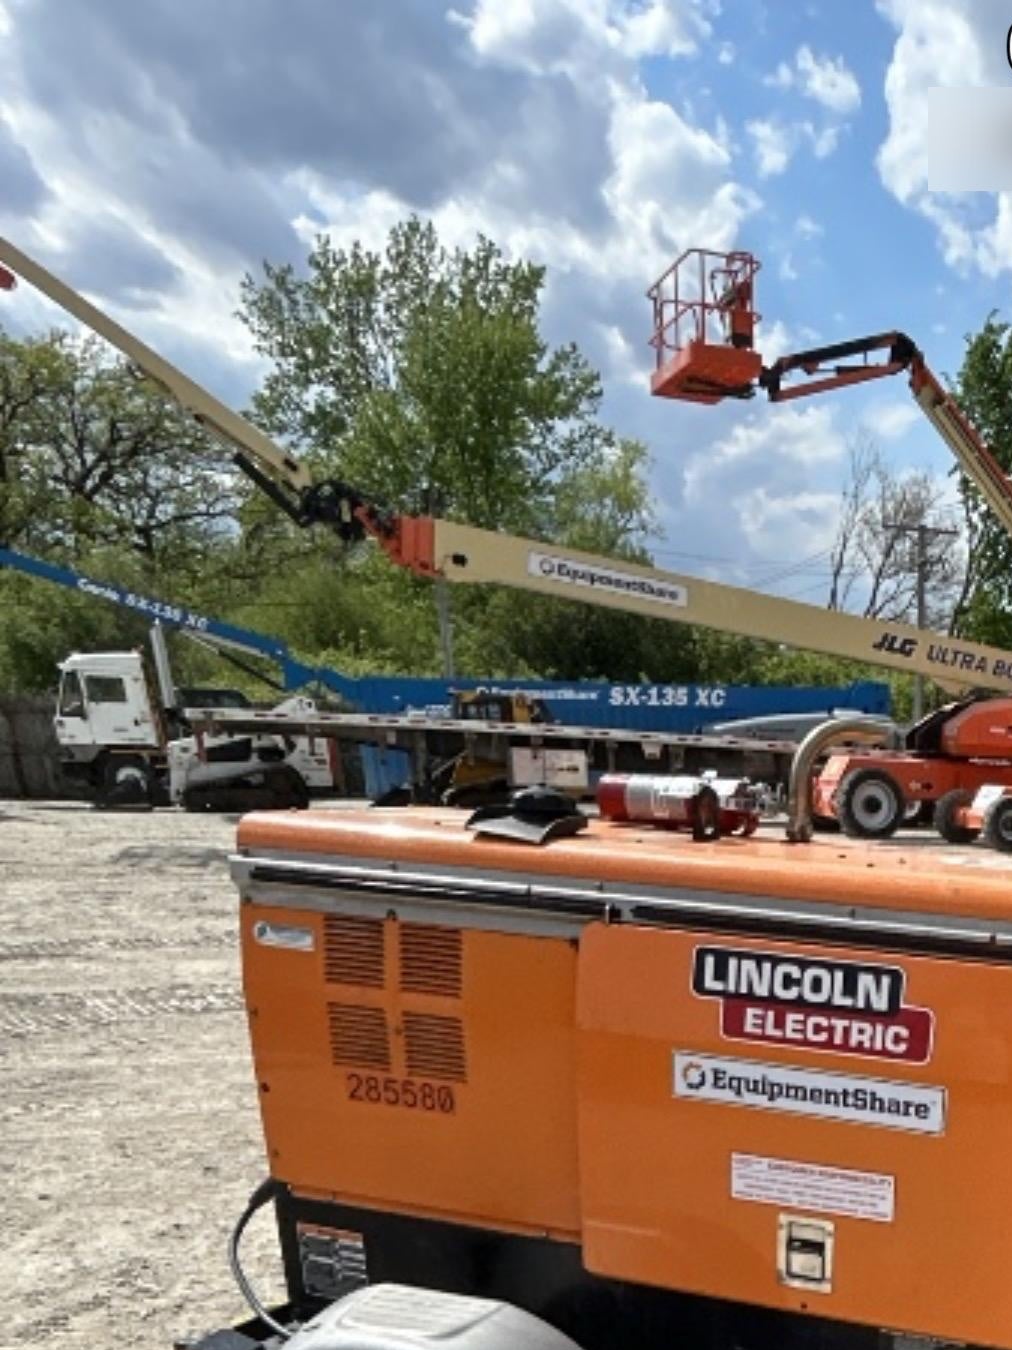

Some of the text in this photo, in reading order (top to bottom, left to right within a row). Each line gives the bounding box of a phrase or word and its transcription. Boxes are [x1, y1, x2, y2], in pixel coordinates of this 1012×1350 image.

[557, 562, 679, 600] EquipmentShare
[872, 632, 918, 657] JLG
[926, 644, 988, 673] ULTRA
[608, 686, 727, 707] SX-135 XC
[703, 954, 892, 1012] LINCOLN
[743, 1007, 910, 1053] ELECTRIC
[347, 1073, 454, 1113] 285580
[710, 1067, 931, 1120] EquipmentShare
